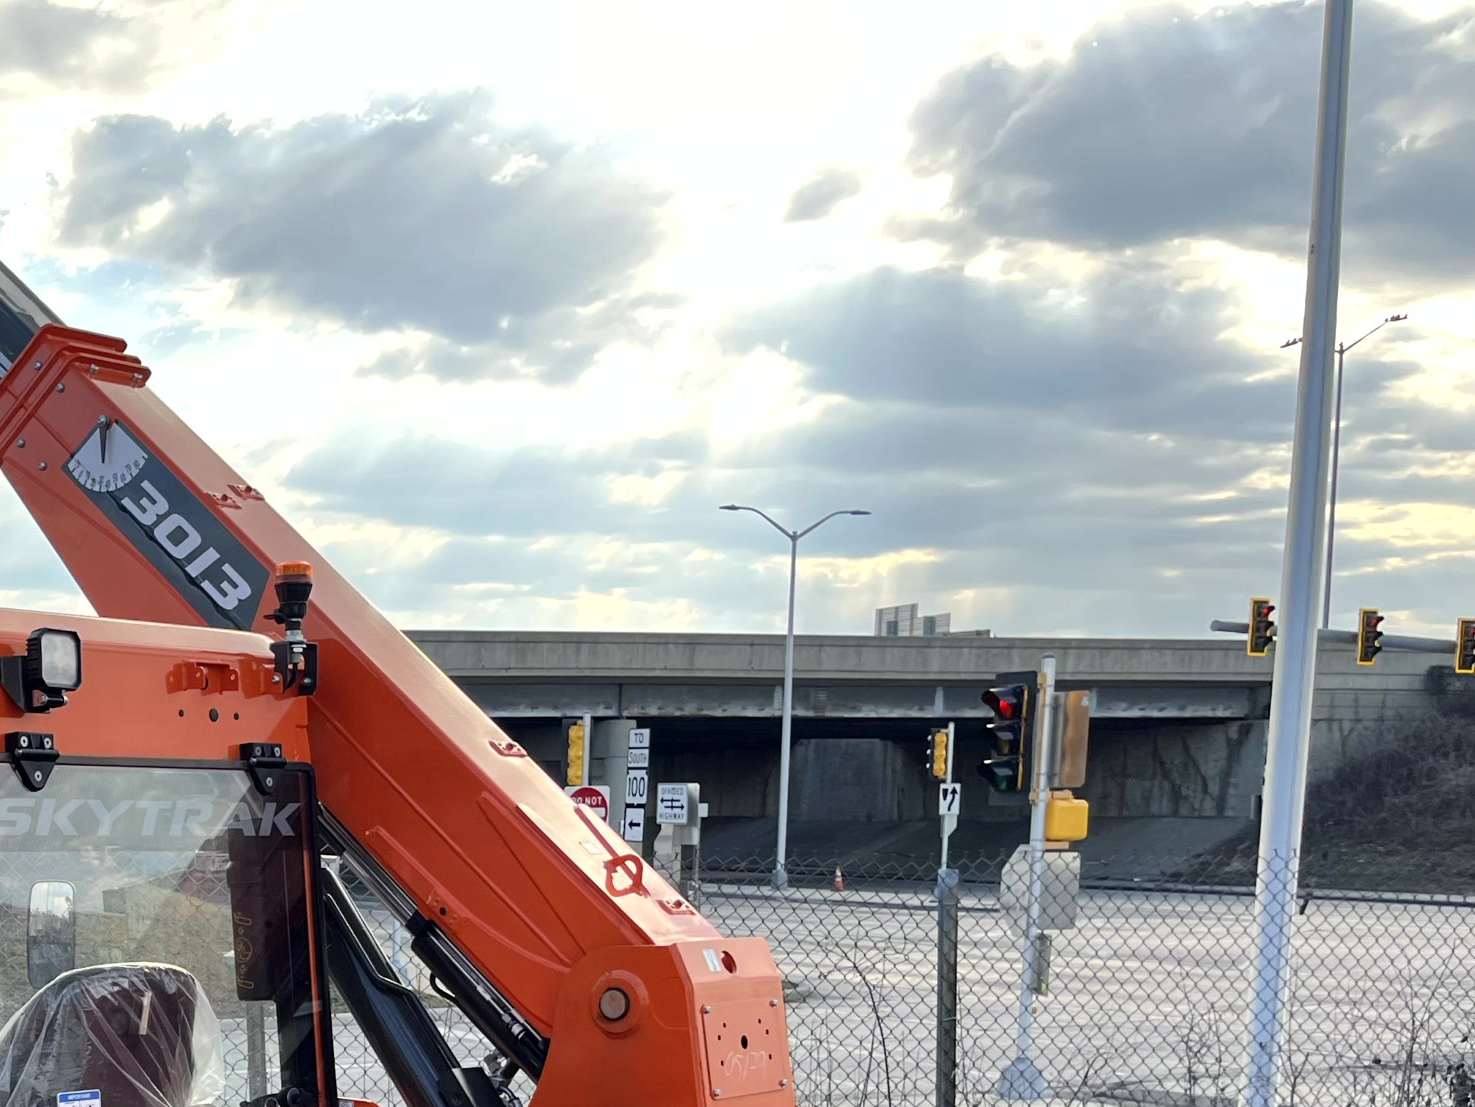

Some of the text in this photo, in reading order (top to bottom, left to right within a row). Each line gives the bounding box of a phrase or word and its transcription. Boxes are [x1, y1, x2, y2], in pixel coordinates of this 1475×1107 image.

[120, 479, 252, 611] 3013
[634, 733, 644, 744] TO
[628, 751, 647, 764] SOUTH
[628, 777, 645, 797] 100
[661, 787, 684, 796] DIVIDED
[584, 796, 603, 806] NOT
[659, 812, 685, 820] HIGHWAY
